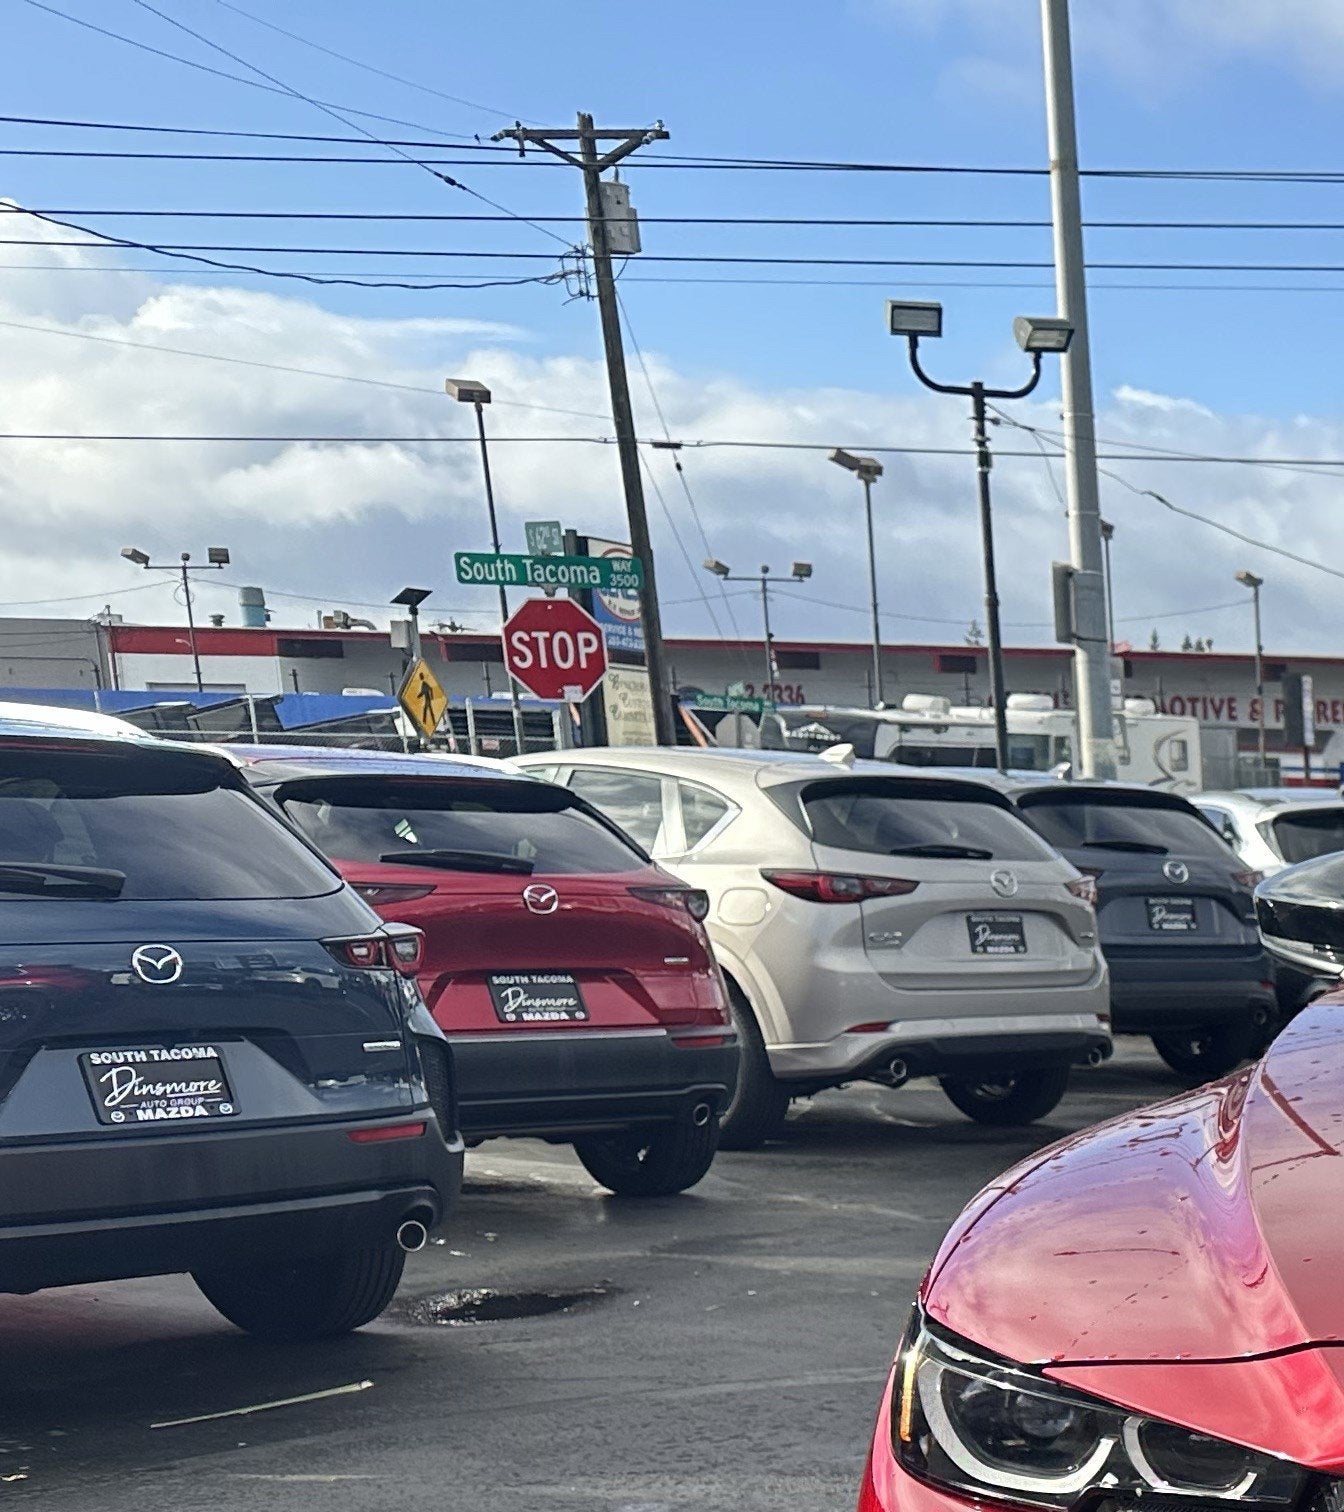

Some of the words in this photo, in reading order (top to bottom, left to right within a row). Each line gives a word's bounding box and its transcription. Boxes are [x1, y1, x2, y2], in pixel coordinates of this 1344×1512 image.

[459, 556, 518, 582] South
[522, 558, 601, 585] Tacoma
[611, 560, 632, 573] WAY
[609, 573, 639, 588] 3500
[511, 630, 599, 670] STOP
[1157, 695, 1238, 722] OTIVE
[521, 1011, 570, 1021] MAZDA
[89, 1050, 147, 1065] SOUTH
[149, 1046, 218, 1062] TACOMA
[100, 1066, 222, 1107] Dinsmore
[140, 1100, 168, 1109] AUTO
[170, 1097, 205, 1106] GROUP
[136, 1105, 209, 1121] MAZDA
